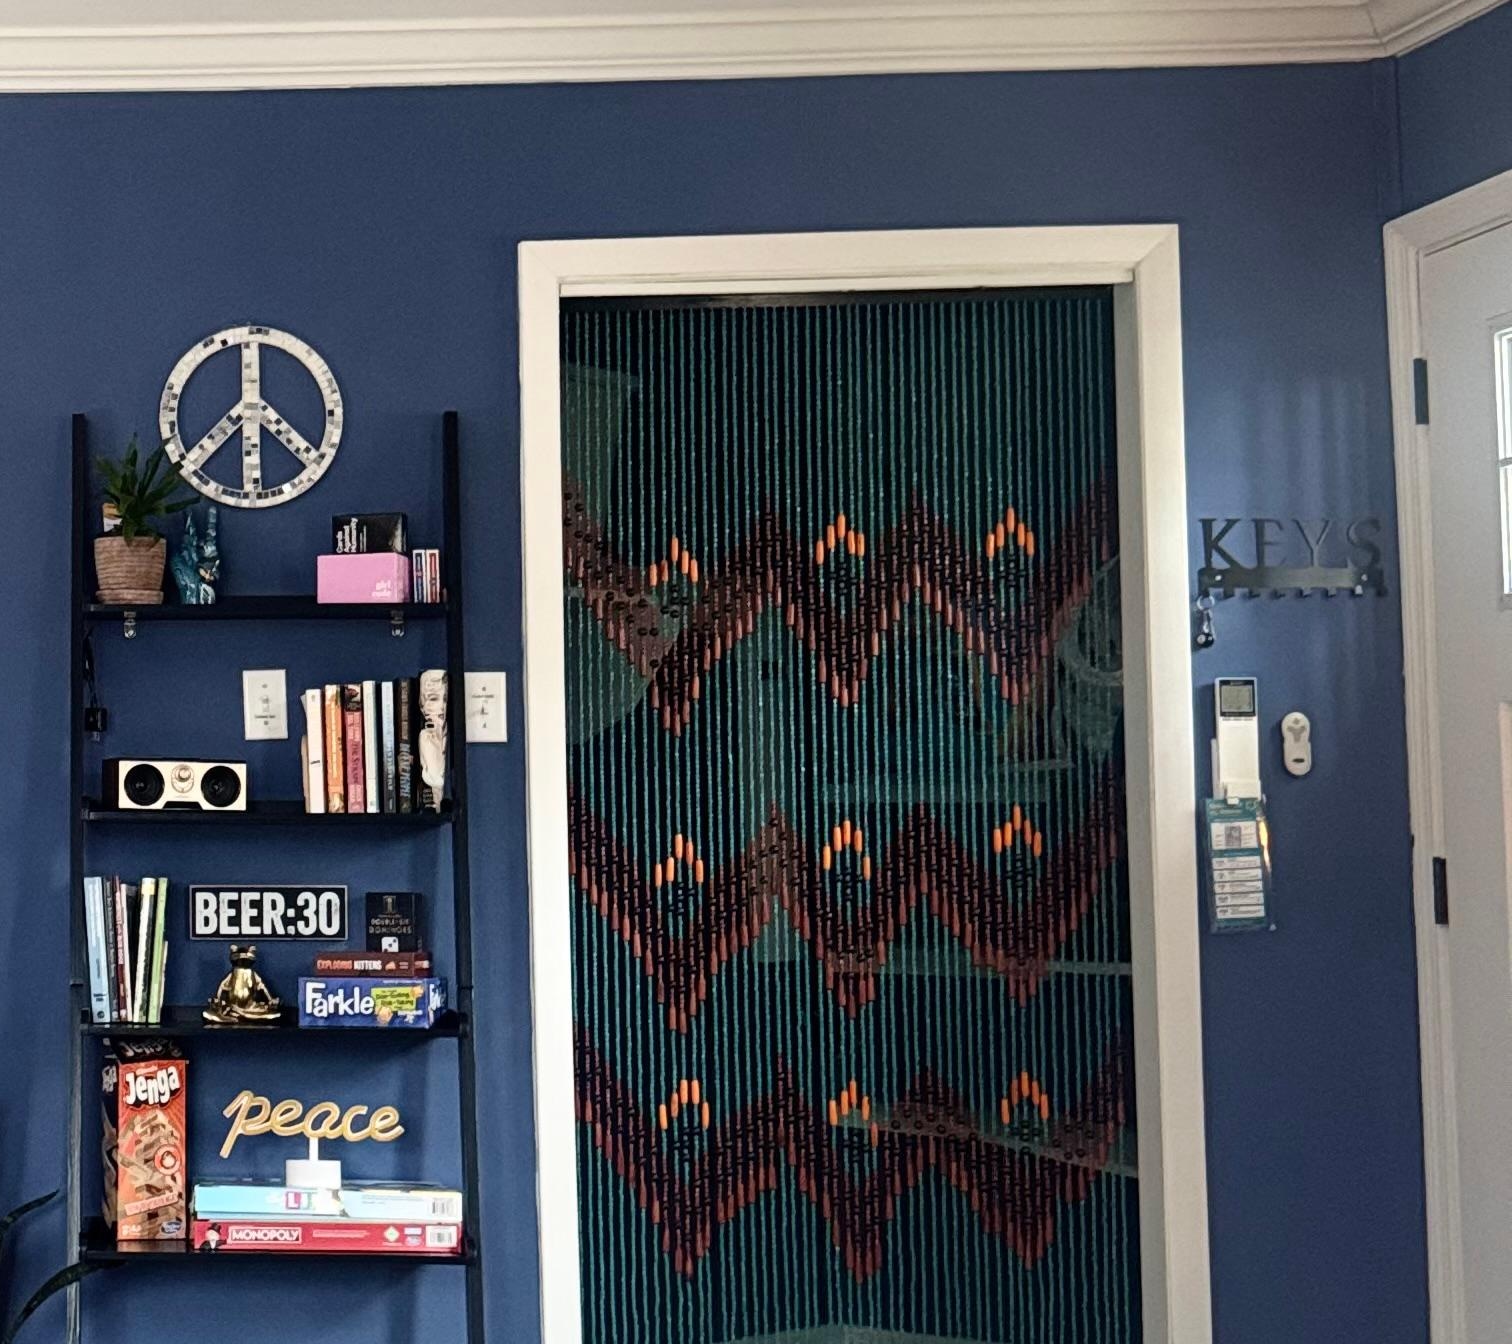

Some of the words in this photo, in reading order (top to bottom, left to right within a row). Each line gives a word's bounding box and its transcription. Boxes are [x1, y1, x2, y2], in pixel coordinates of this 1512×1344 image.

[1198, 518, 1383, 569] KEYS
[195, 891, 341, 936] BEER:30
[353, 959, 382, 971] KITTENS
[305, 981, 375, 1018] Farkle
[125, 1066, 180, 1105] Jenga
[219, 1090, 405, 1159] peace
[232, 1229, 299, 1241] MONOPOLY
